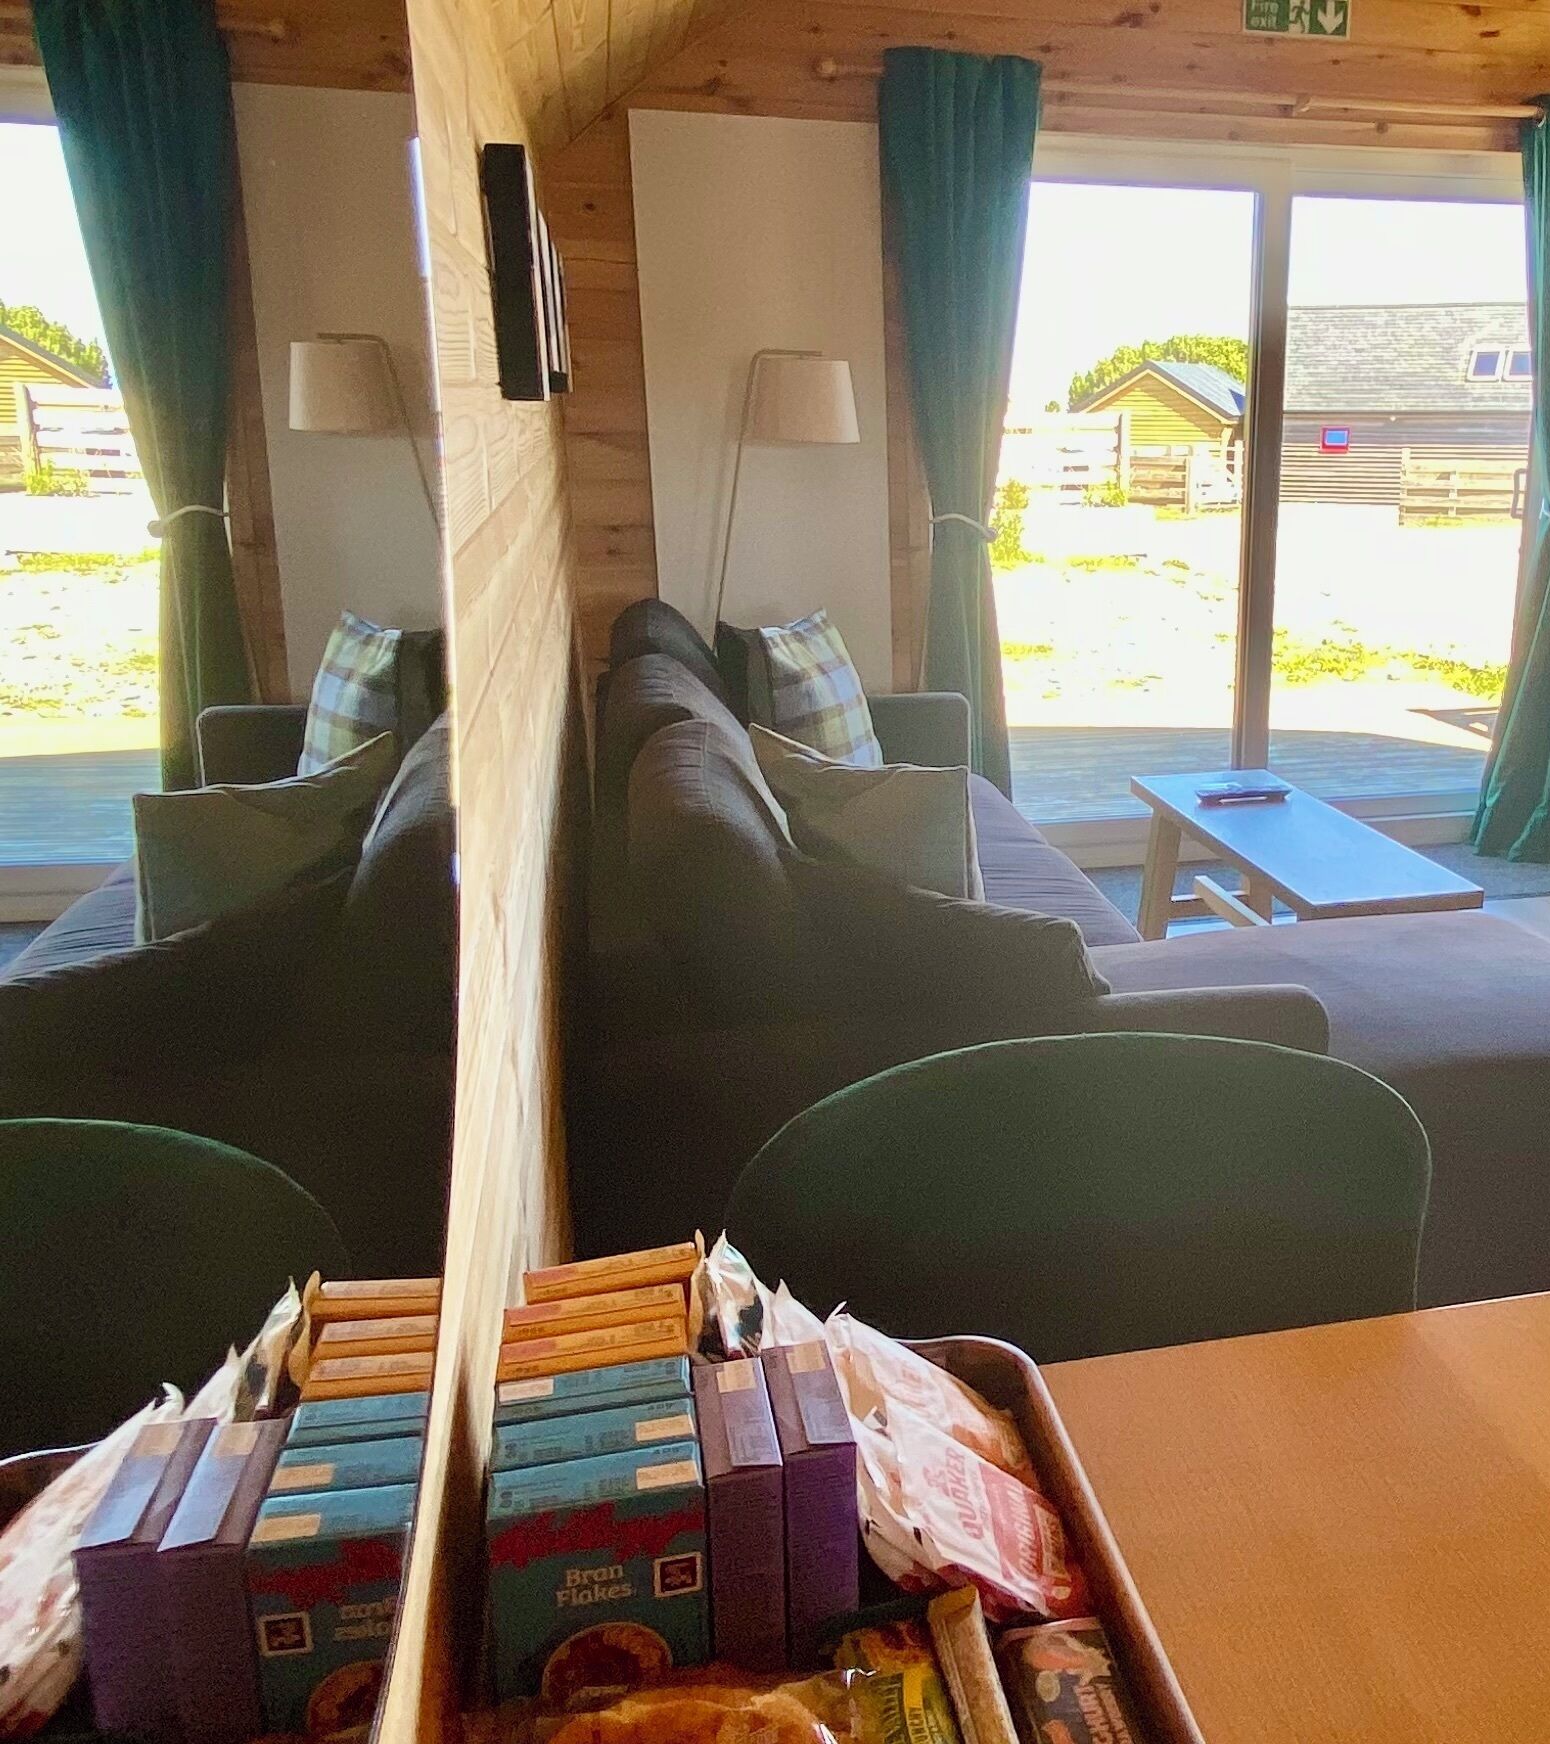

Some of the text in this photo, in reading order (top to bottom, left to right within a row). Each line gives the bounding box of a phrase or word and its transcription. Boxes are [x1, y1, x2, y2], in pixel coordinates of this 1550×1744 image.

[1250, 15, 1277, 29] exit
[945, 1446, 985, 1541] QUAKER
[1007, 1484, 1043, 1582] ORIGINAL
[565, 1563, 625, 1588] Bran
[556, 1582, 634, 1608] Flakes
